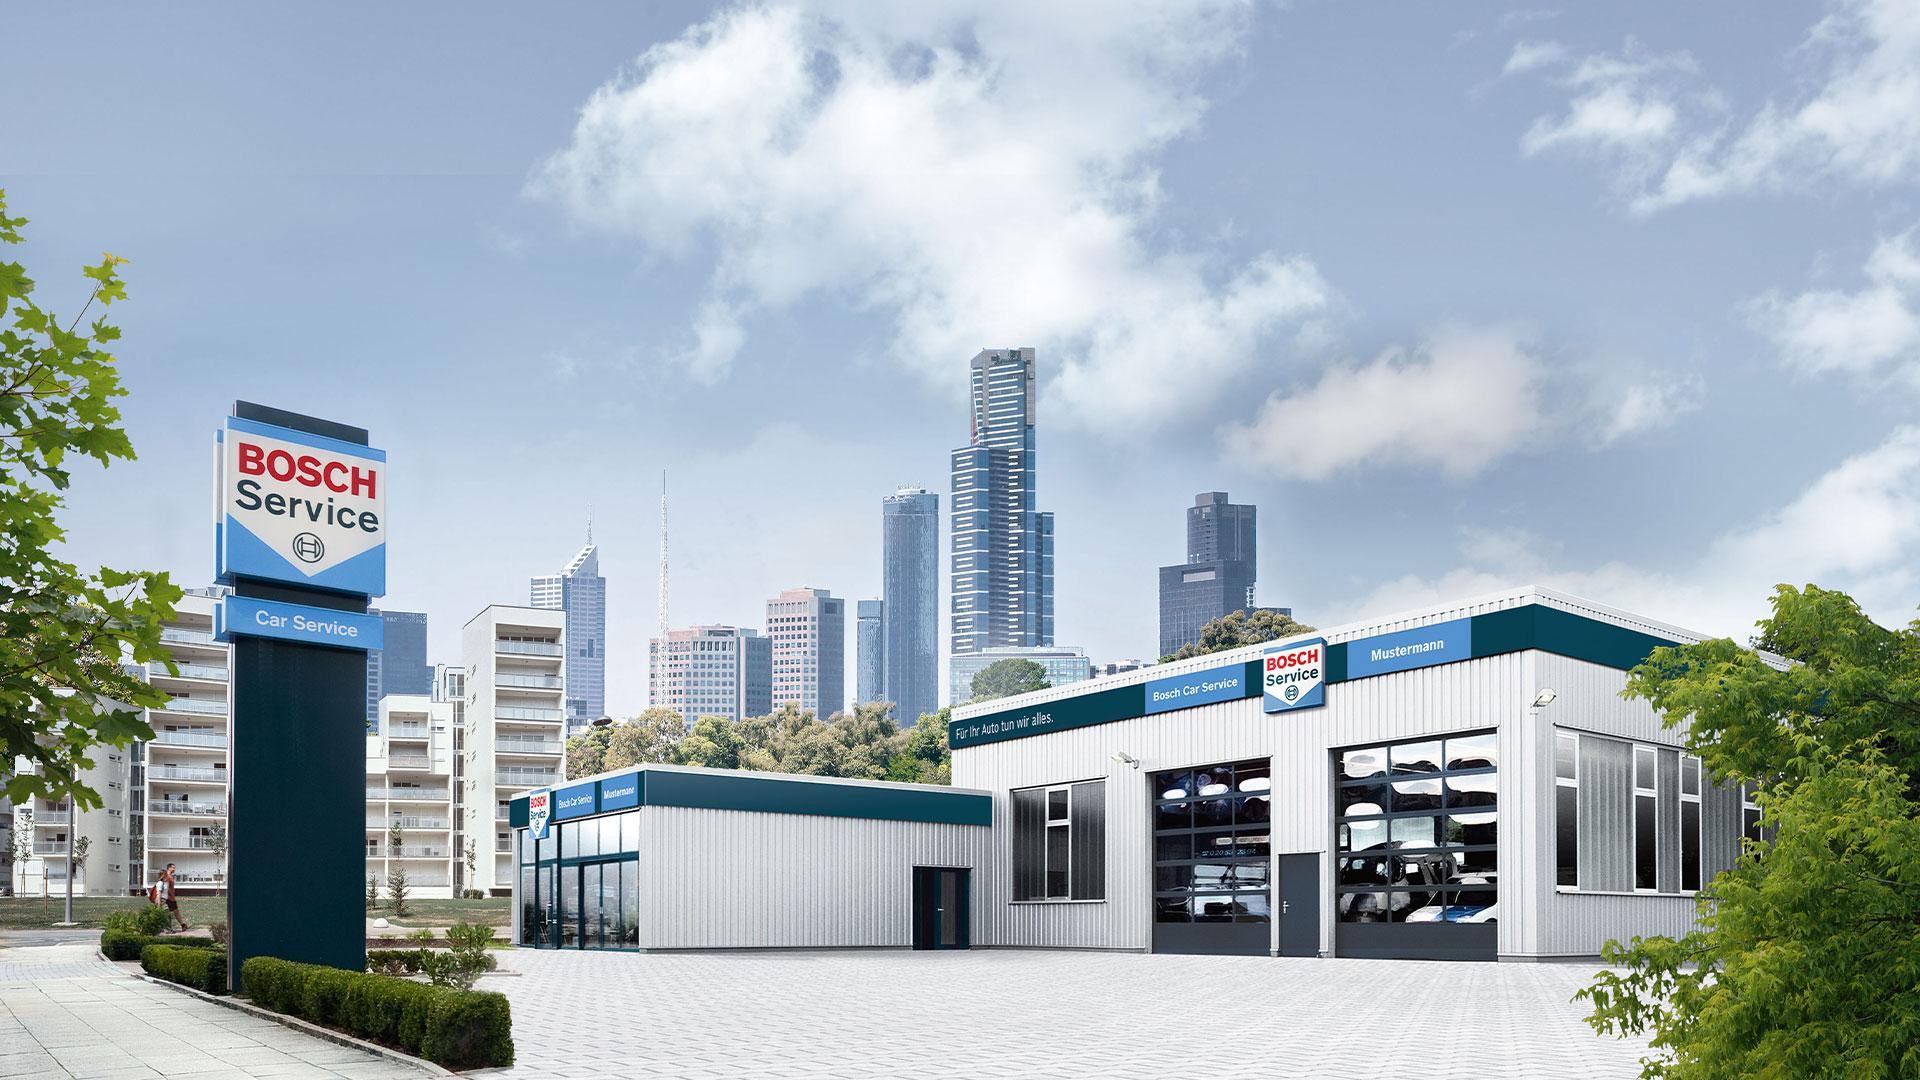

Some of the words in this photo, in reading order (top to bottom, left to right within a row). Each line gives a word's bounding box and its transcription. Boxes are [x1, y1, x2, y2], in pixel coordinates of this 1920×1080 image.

[238, 442, 376, 499] BOSCH
[235, 479, 379, 533] Service
[255, 610, 288, 628] Car
[293, 615, 358, 637] Service
[1266, 648, 1319, 672] BOSCH
[1371, 640, 1444, 662] Mustermann
[1153, 687, 1181, 702] Bosch
[1183, 684, 1200, 697] Car
[1201, 677, 1238, 692] Service
[1266, 667, 1319, 687] Service
[956, 728, 967, 740] Für
[969, 725, 980, 737] Ihr
[981, 722, 999, 736] Auto
[1001, 720, 1015, 732] tun
[1016, 715, 1030, 728] wir
[1031, 711, 1054, 727] alles.
[530, 795, 547, 809] BOSCH
